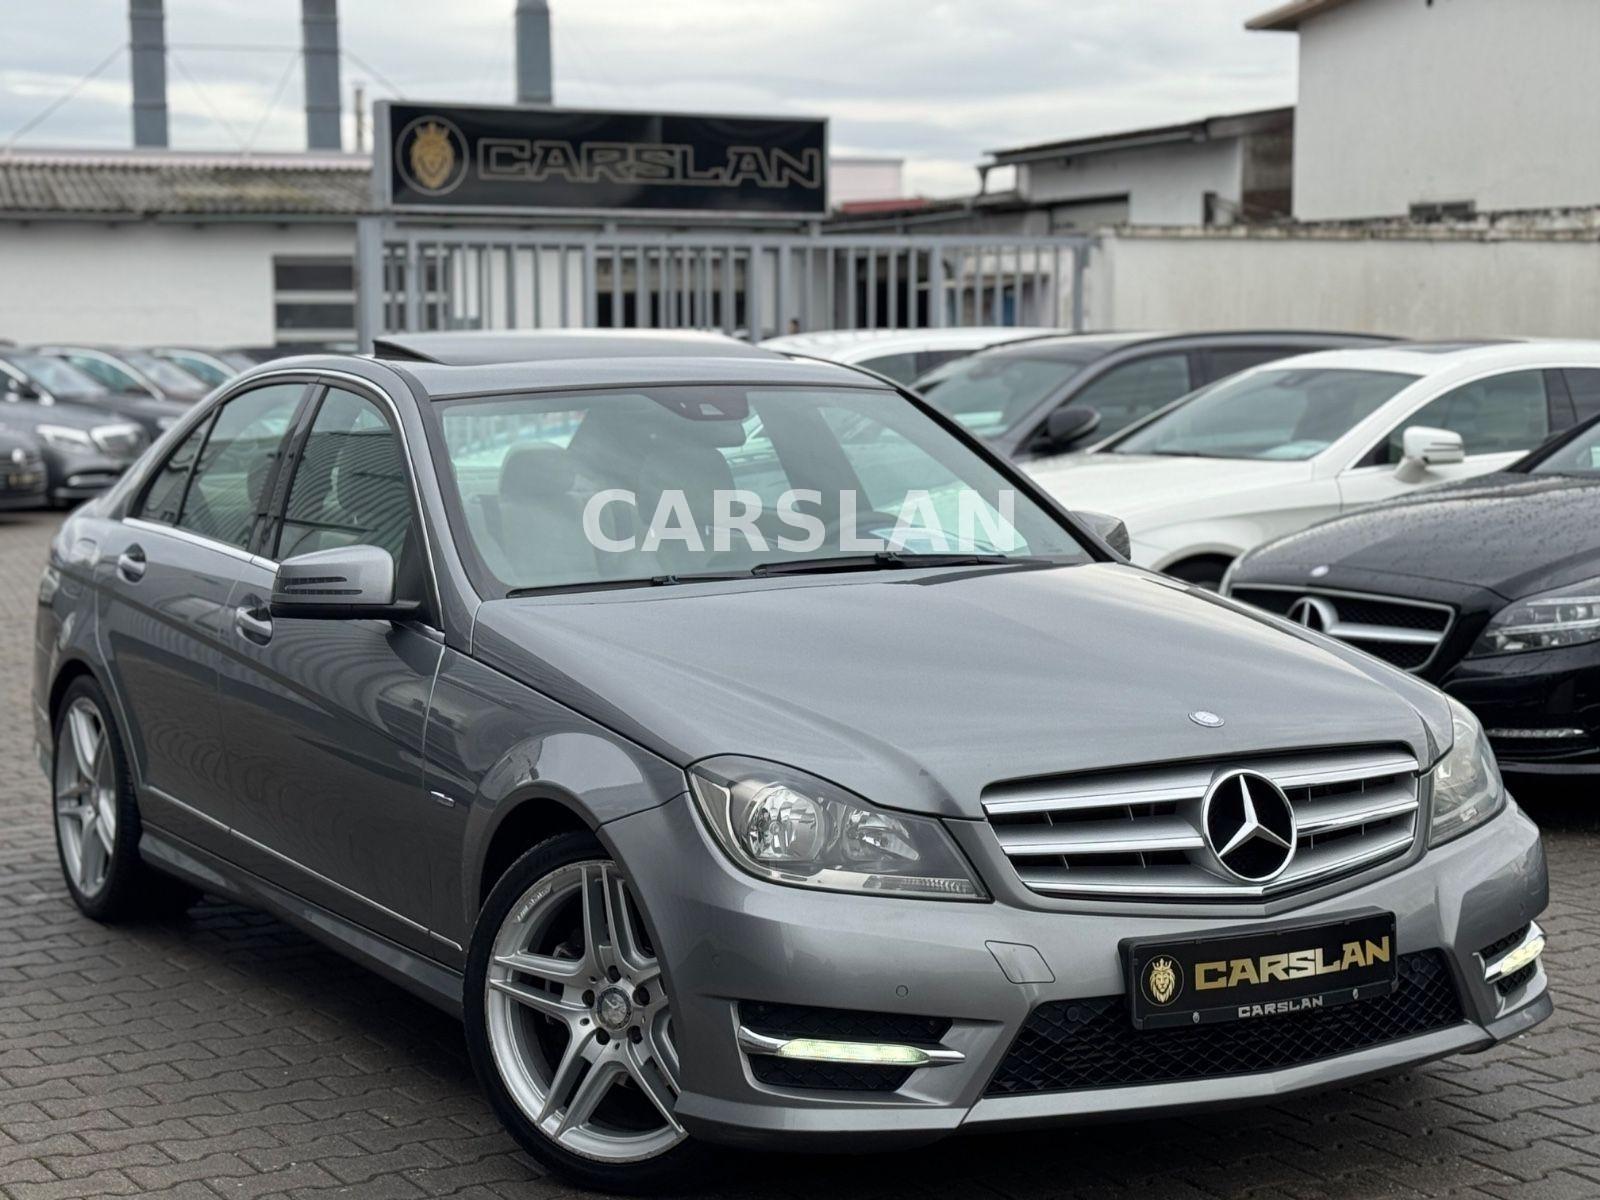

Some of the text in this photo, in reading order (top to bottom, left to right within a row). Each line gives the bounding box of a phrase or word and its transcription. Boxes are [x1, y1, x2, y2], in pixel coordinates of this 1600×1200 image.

[477, 137, 820, 189] CARSLAN
[1195, 936, 1390, 991] CARSLAN
[1238, 995, 1323, 1018] CARSLAN
